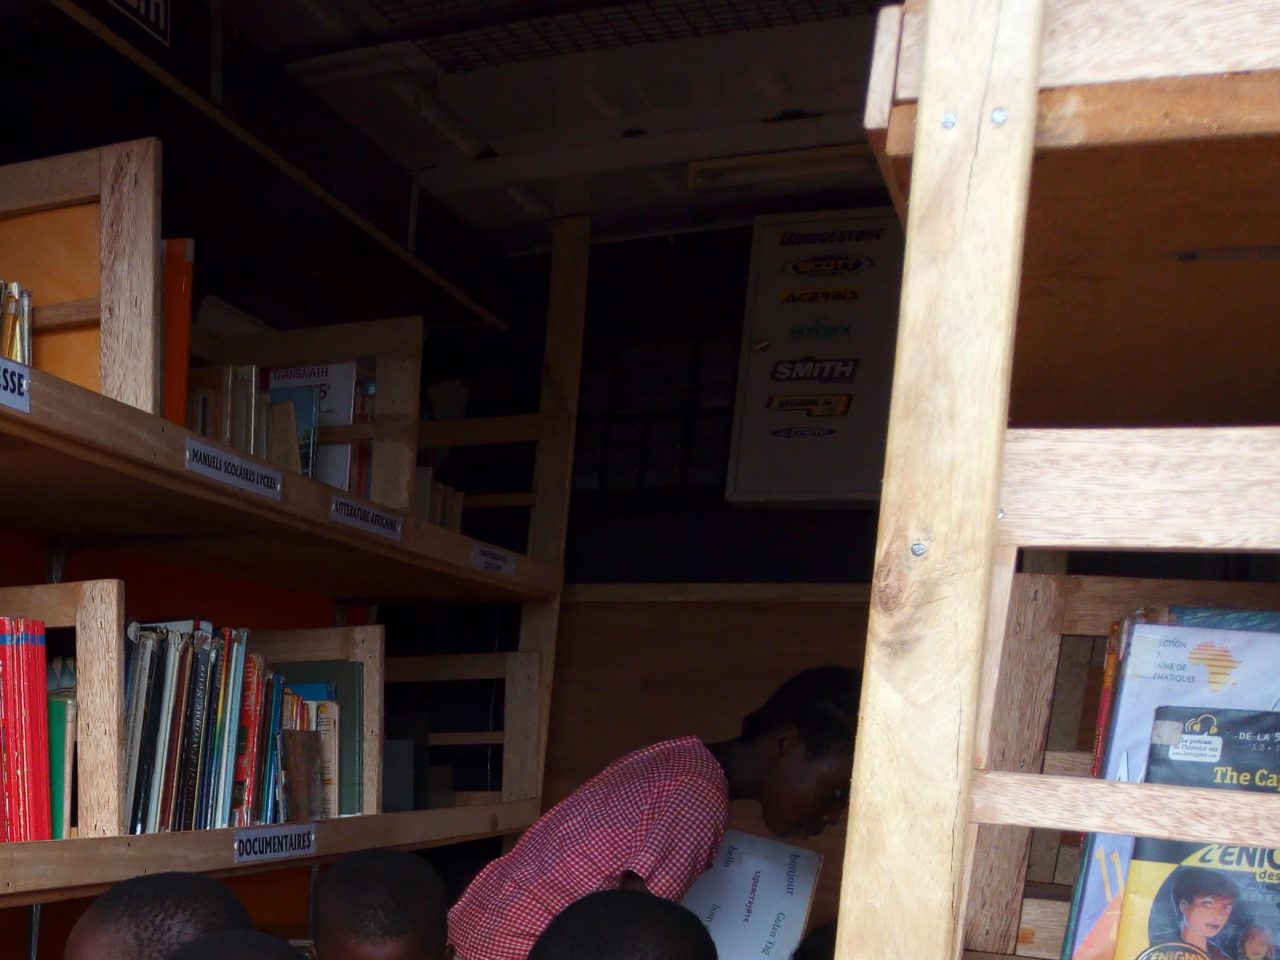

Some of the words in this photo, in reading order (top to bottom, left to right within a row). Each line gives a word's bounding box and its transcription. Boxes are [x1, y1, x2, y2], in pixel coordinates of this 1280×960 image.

[272, 368, 328, 381] TRANSMATH
[774, 359, 855, 380] SMITH
[192, 448, 222, 472] MANUELS
[223, 461, 255, 482] SCOLAIRES
[1239, 732, 1252, 740] DE
[1257, 733, 1269, 741] LA
[1214, 767, 1251, 785] The
[238, 830, 310, 859] DOCUMENTAIRES
[724, 847, 738, 868] hello
[786, 854, 800, 896] bonjour
[770, 912, 786, 939] Guten
[761, 941, 777, 955] Tag
